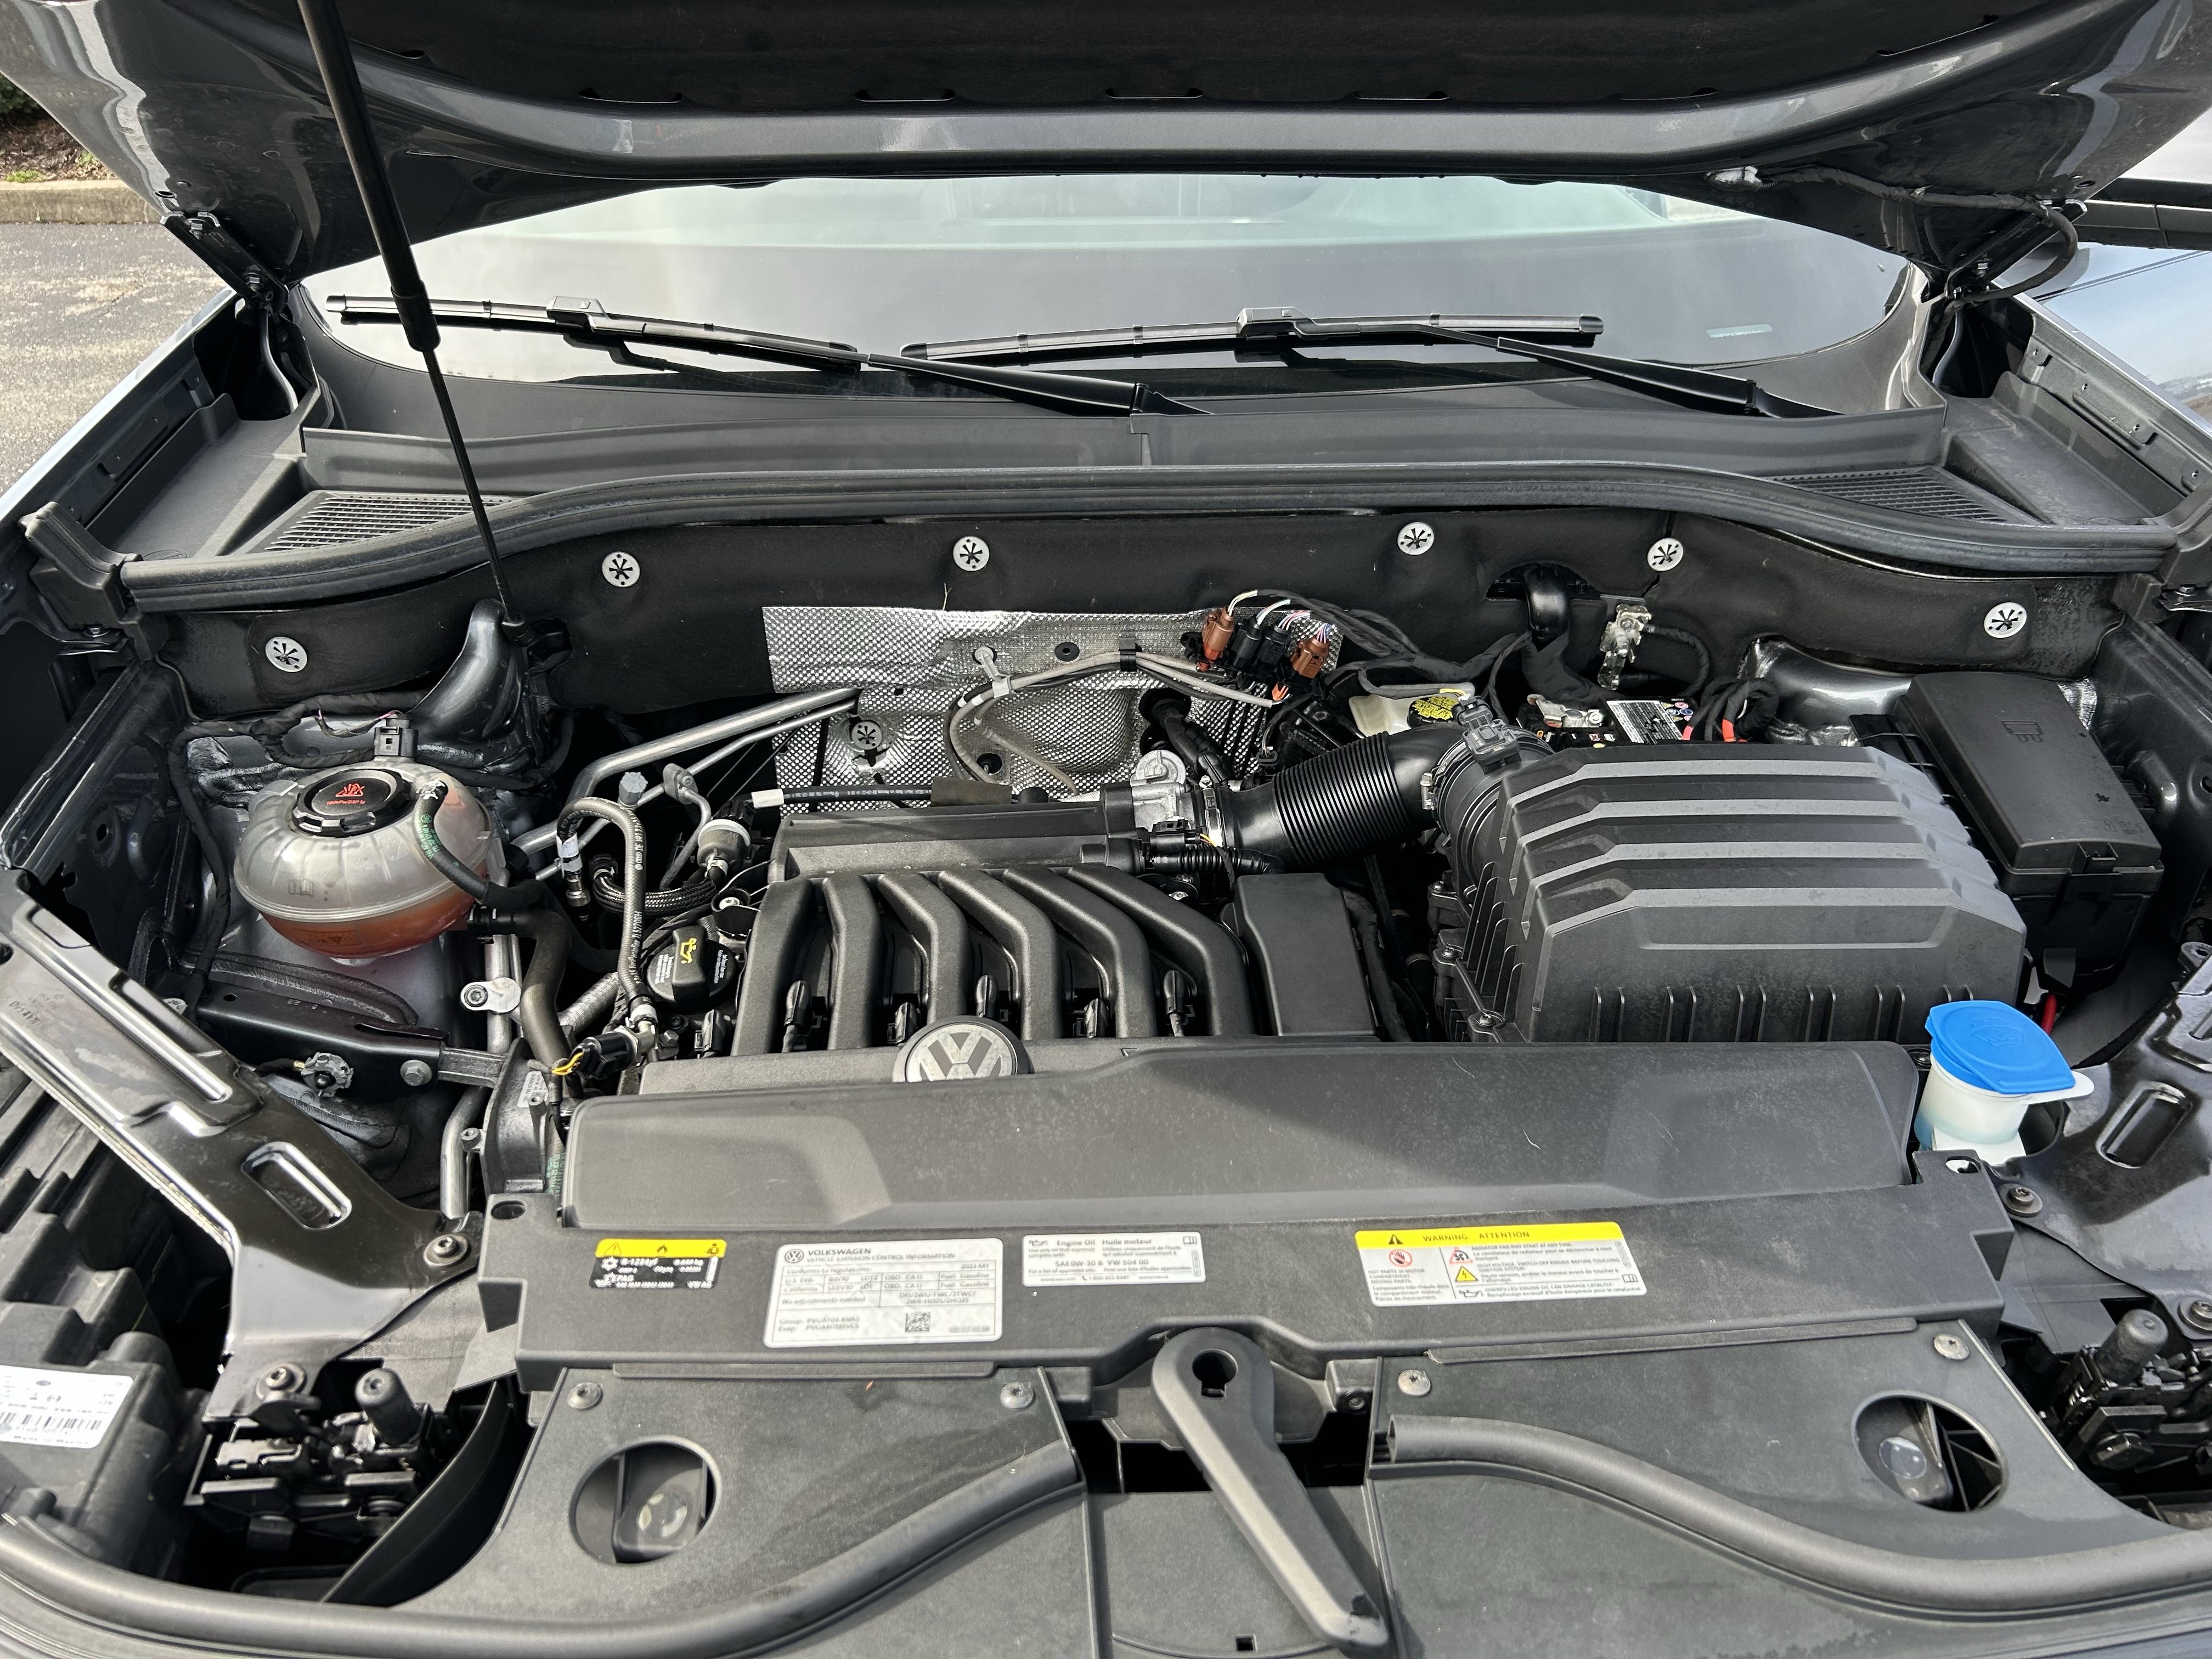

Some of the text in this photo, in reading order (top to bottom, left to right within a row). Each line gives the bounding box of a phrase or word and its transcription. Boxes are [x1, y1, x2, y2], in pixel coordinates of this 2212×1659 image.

[1422, 1231, 1530, 1242] WARNING ATTENTION
[619, 1258, 659, 1267] R-1234yf
